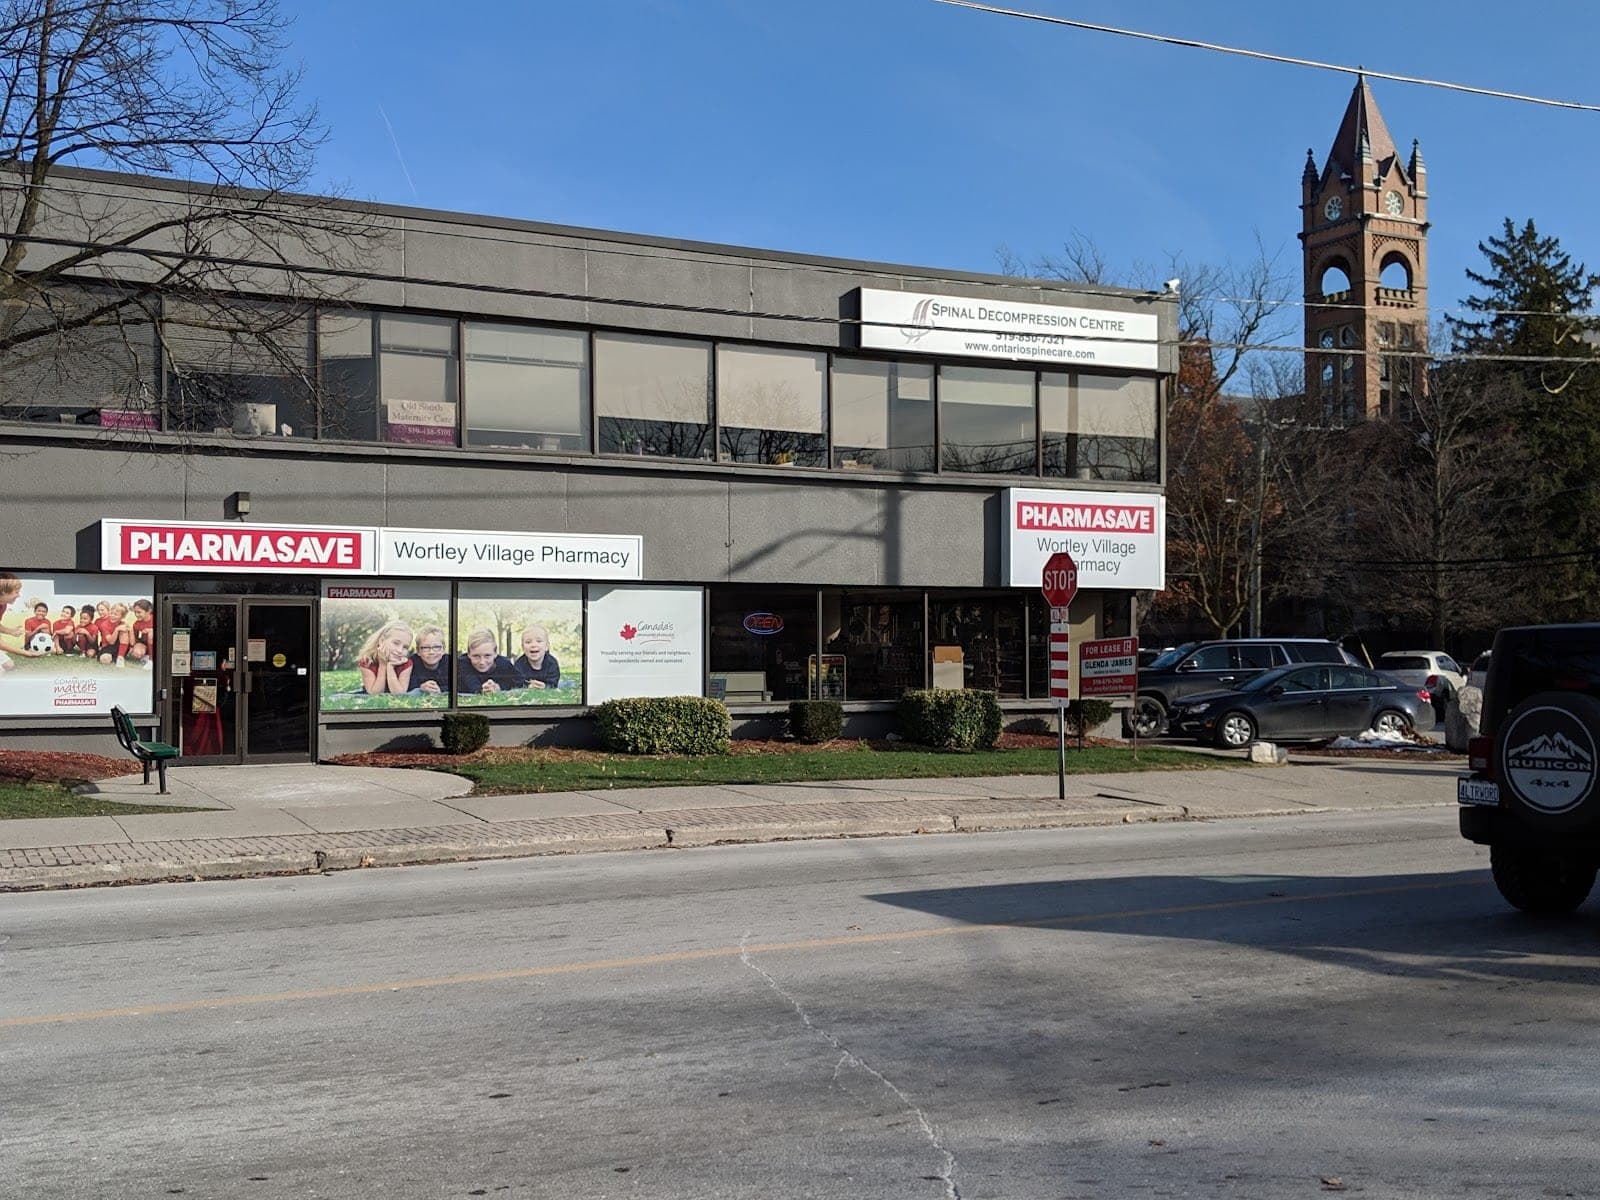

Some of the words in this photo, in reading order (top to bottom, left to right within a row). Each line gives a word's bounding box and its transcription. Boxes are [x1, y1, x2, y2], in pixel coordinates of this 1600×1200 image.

[964, 342, 1096, 359] www.ontariospinecare.com
[1021, 505, 1150, 530] PHARMASAVE
[130, 531, 353, 564] PHARMASAVE
[394, 541, 467, 564] Wortley
[473, 543, 535, 565] Village
[541, 545, 630, 568] Pharmacy
[1037, 537, 1088, 556] Wortley
[1092, 539, 1136, 557] Village
[1074, 559, 1121, 576] armacy
[1044, 570, 1076, 591] STOP
[330, 588, 393, 598] PHARMASAVE
[637, 620, 674, 631] Canada's
[1085, 646, 1099, 655] FOR
[1100, 644, 1121, 654] LEASE
[1110, 658, 1133, 668] JAMES
[1508, 758, 1592, 772] RUBICON
[1529, 778, 1571, 789] 4x4
